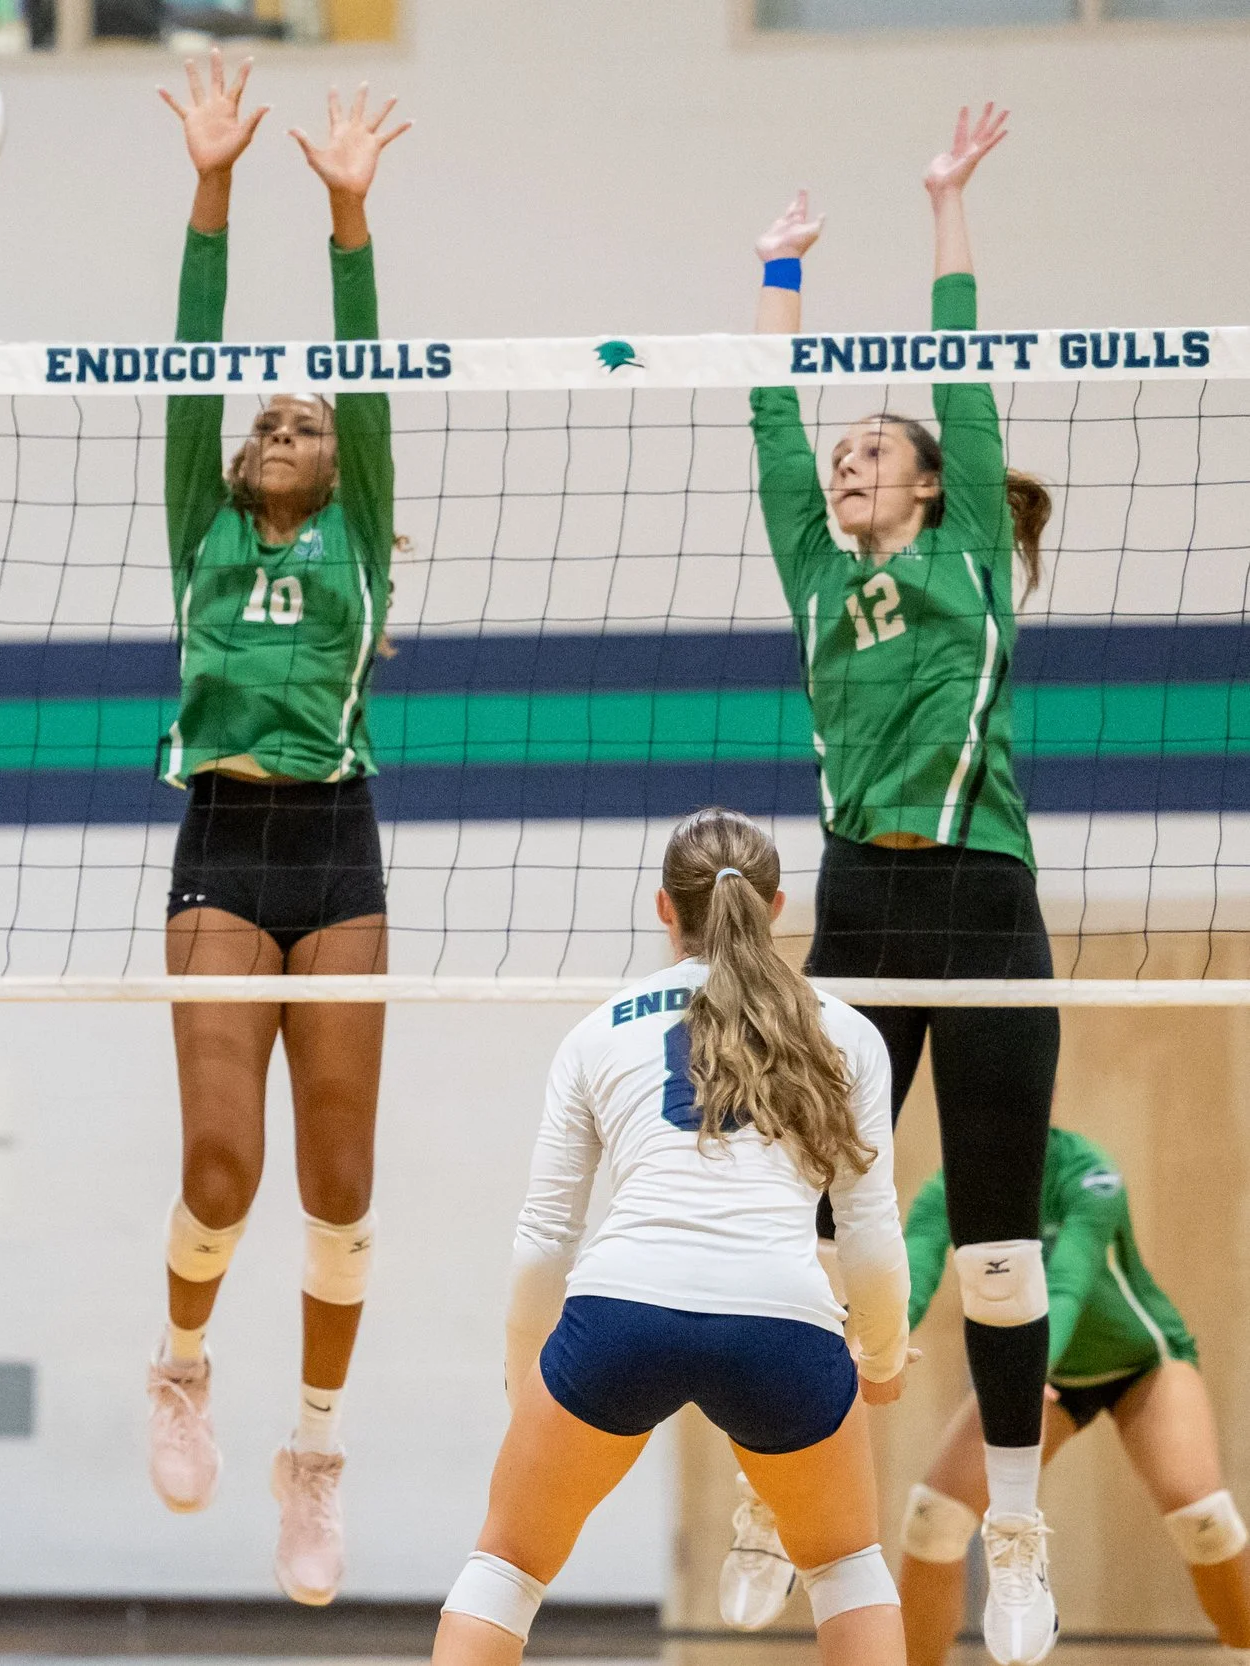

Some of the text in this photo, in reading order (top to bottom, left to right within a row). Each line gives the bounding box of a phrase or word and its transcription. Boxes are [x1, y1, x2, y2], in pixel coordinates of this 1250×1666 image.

[45, 343, 451, 383] ENDICOTT GULLS
[790, 331, 1210, 373] ENDICOTT GULLS
[242, 566, 304, 625] 10
[845, 572, 907, 651] 12
